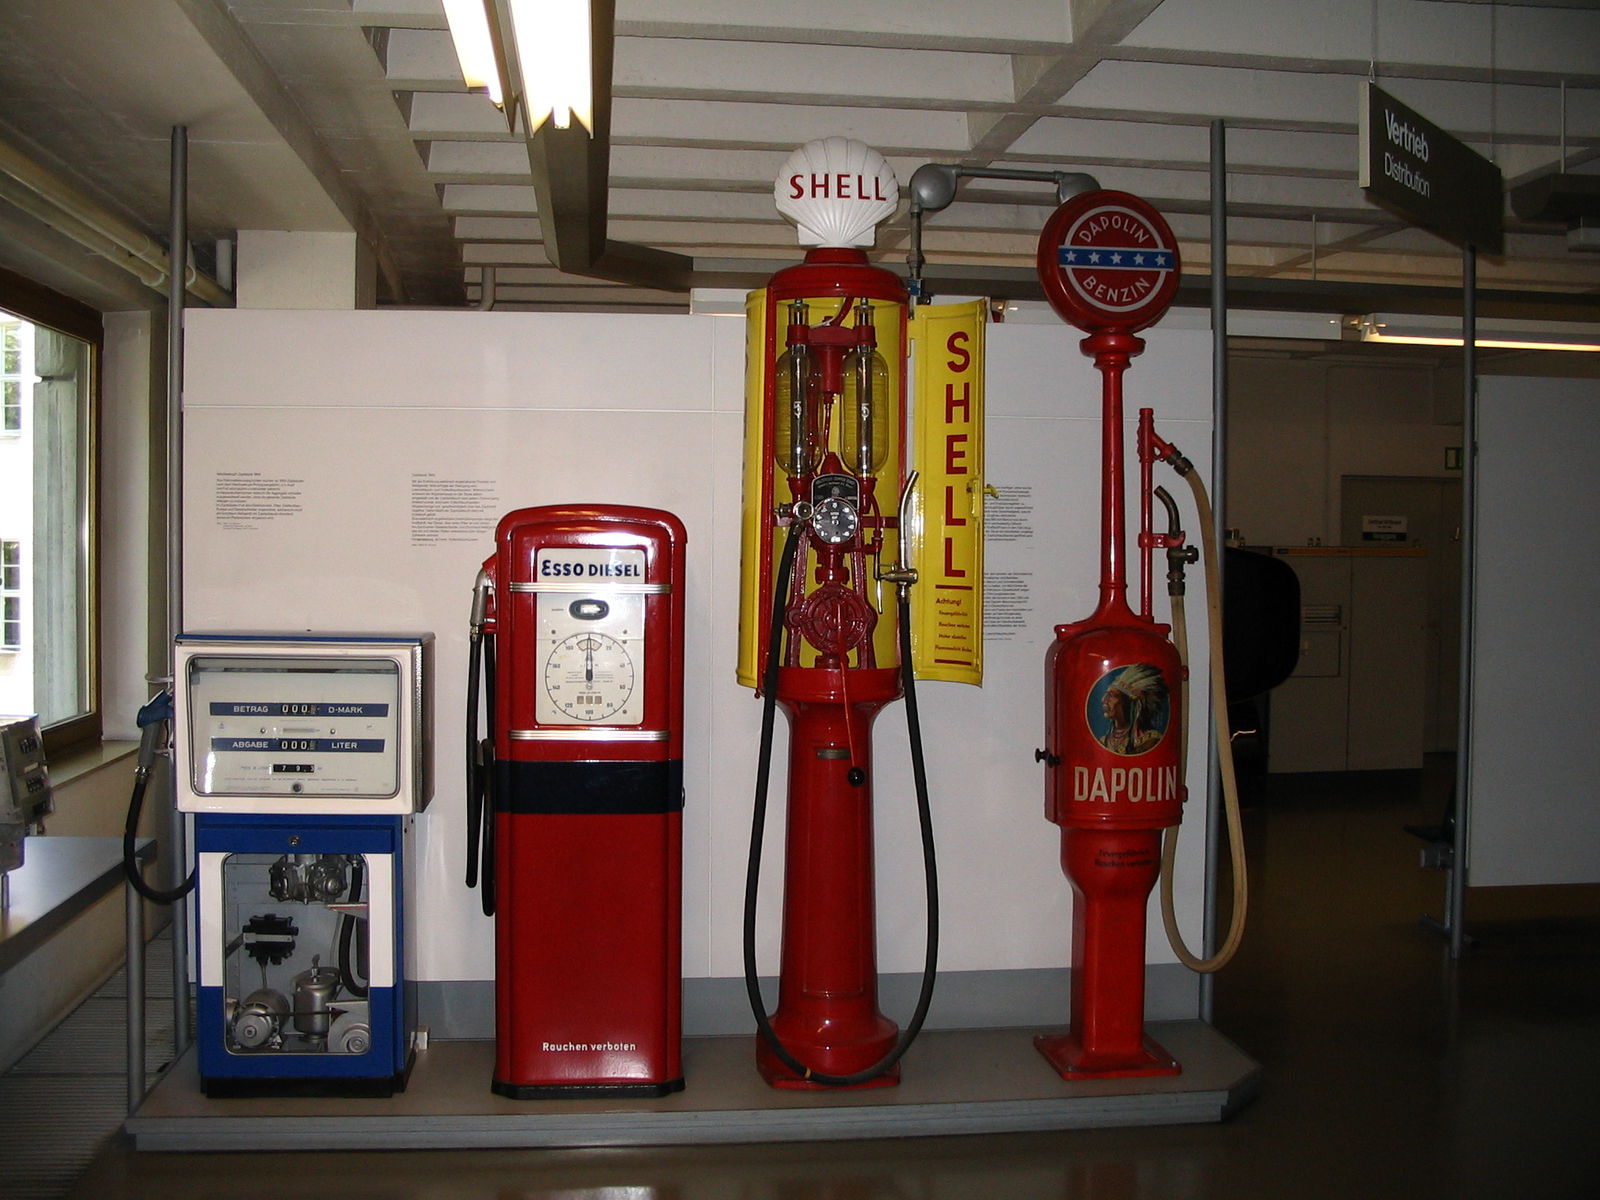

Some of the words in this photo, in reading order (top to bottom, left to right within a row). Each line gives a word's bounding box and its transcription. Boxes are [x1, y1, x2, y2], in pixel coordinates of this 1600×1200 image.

[1384, 108, 1429, 162] Vertrieb
[789, 173, 887, 201] SHELL
[1384, 151, 1430, 198] Distribution
[1079, 215, 1150, 243] DAPOLIN
[1083, 276, 1150, 302] BENZIN
[944, 331, 970, 577] SHELL
[589, 564, 640, 577] DIESEL
[233, 705, 269, 713] BETRAG
[232, 741, 269, 749] ABGABE
[331, 741, 358, 749] LITER
[1074, 765, 1176, 803] DAPOLIN
[542, 1041, 587, 1051] Rauchen
[590, 1041, 636, 1051] verboten
